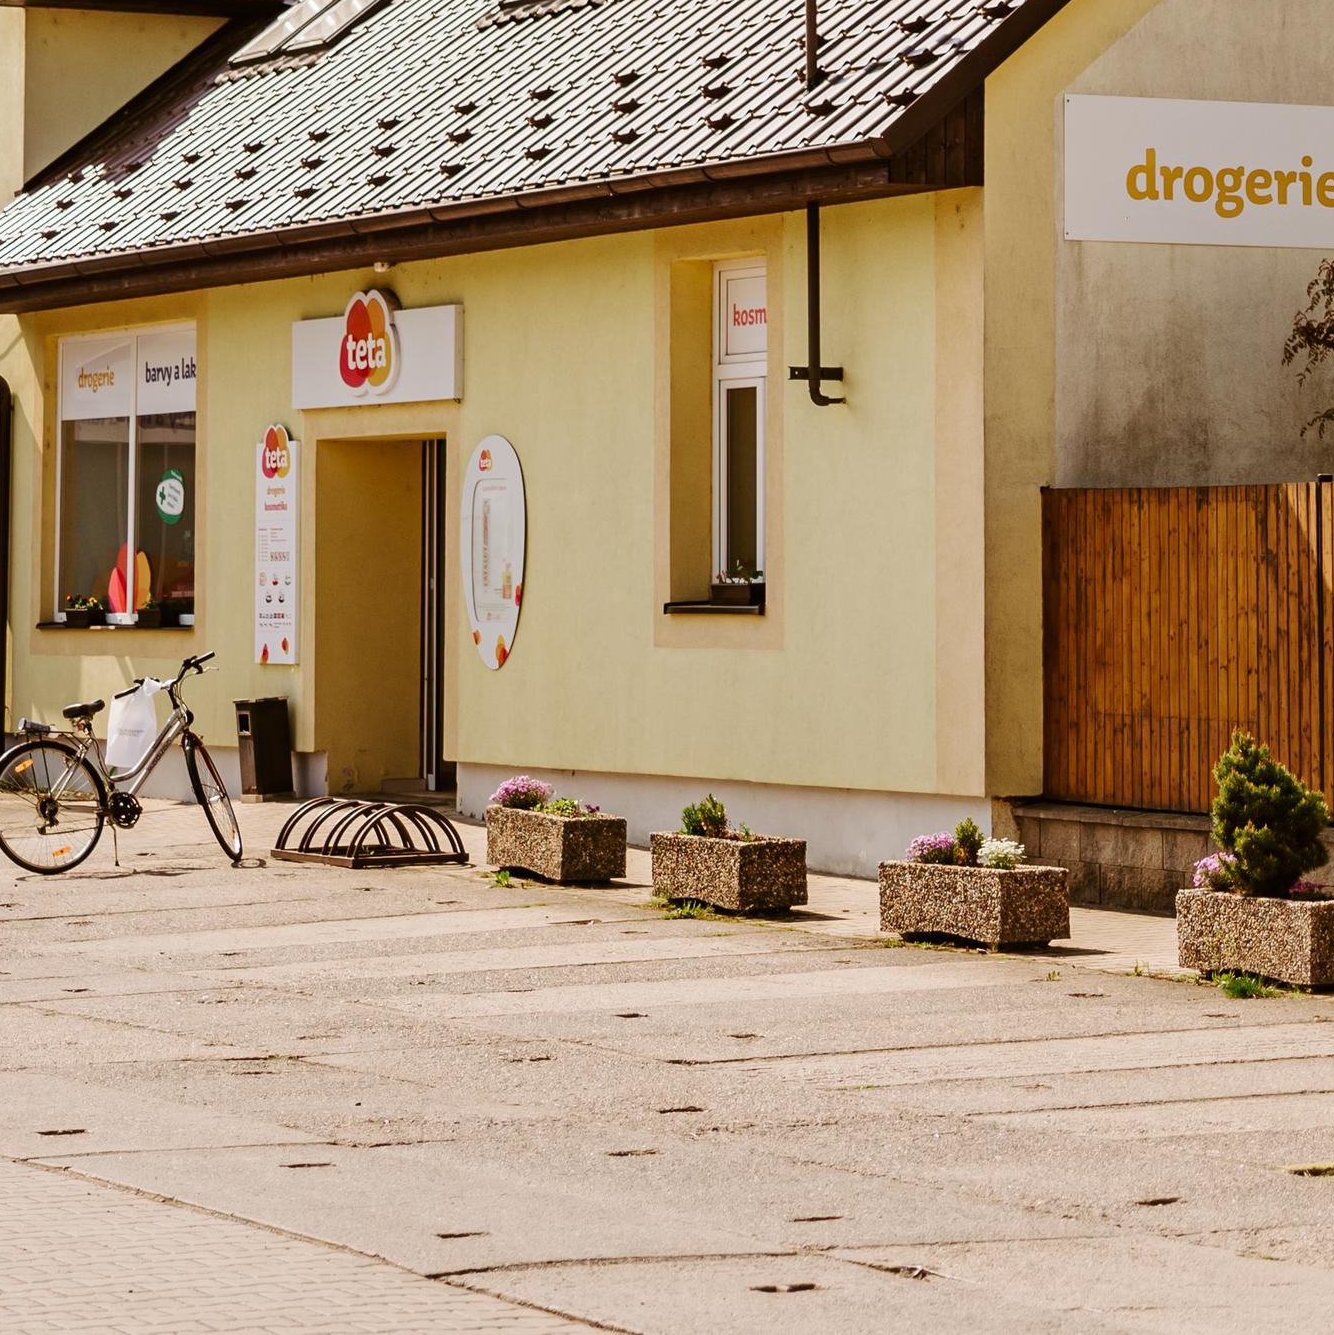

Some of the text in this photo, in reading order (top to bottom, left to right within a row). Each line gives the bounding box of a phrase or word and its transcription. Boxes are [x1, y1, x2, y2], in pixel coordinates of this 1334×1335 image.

[733, 303, 767, 327] kosm
[347, 332, 386, 370] teta
[78, 365, 114, 393] drogerie
[145, 361, 172, 387] barvy
[174, 364, 180, 380] a
[265, 447, 287, 468] teta
